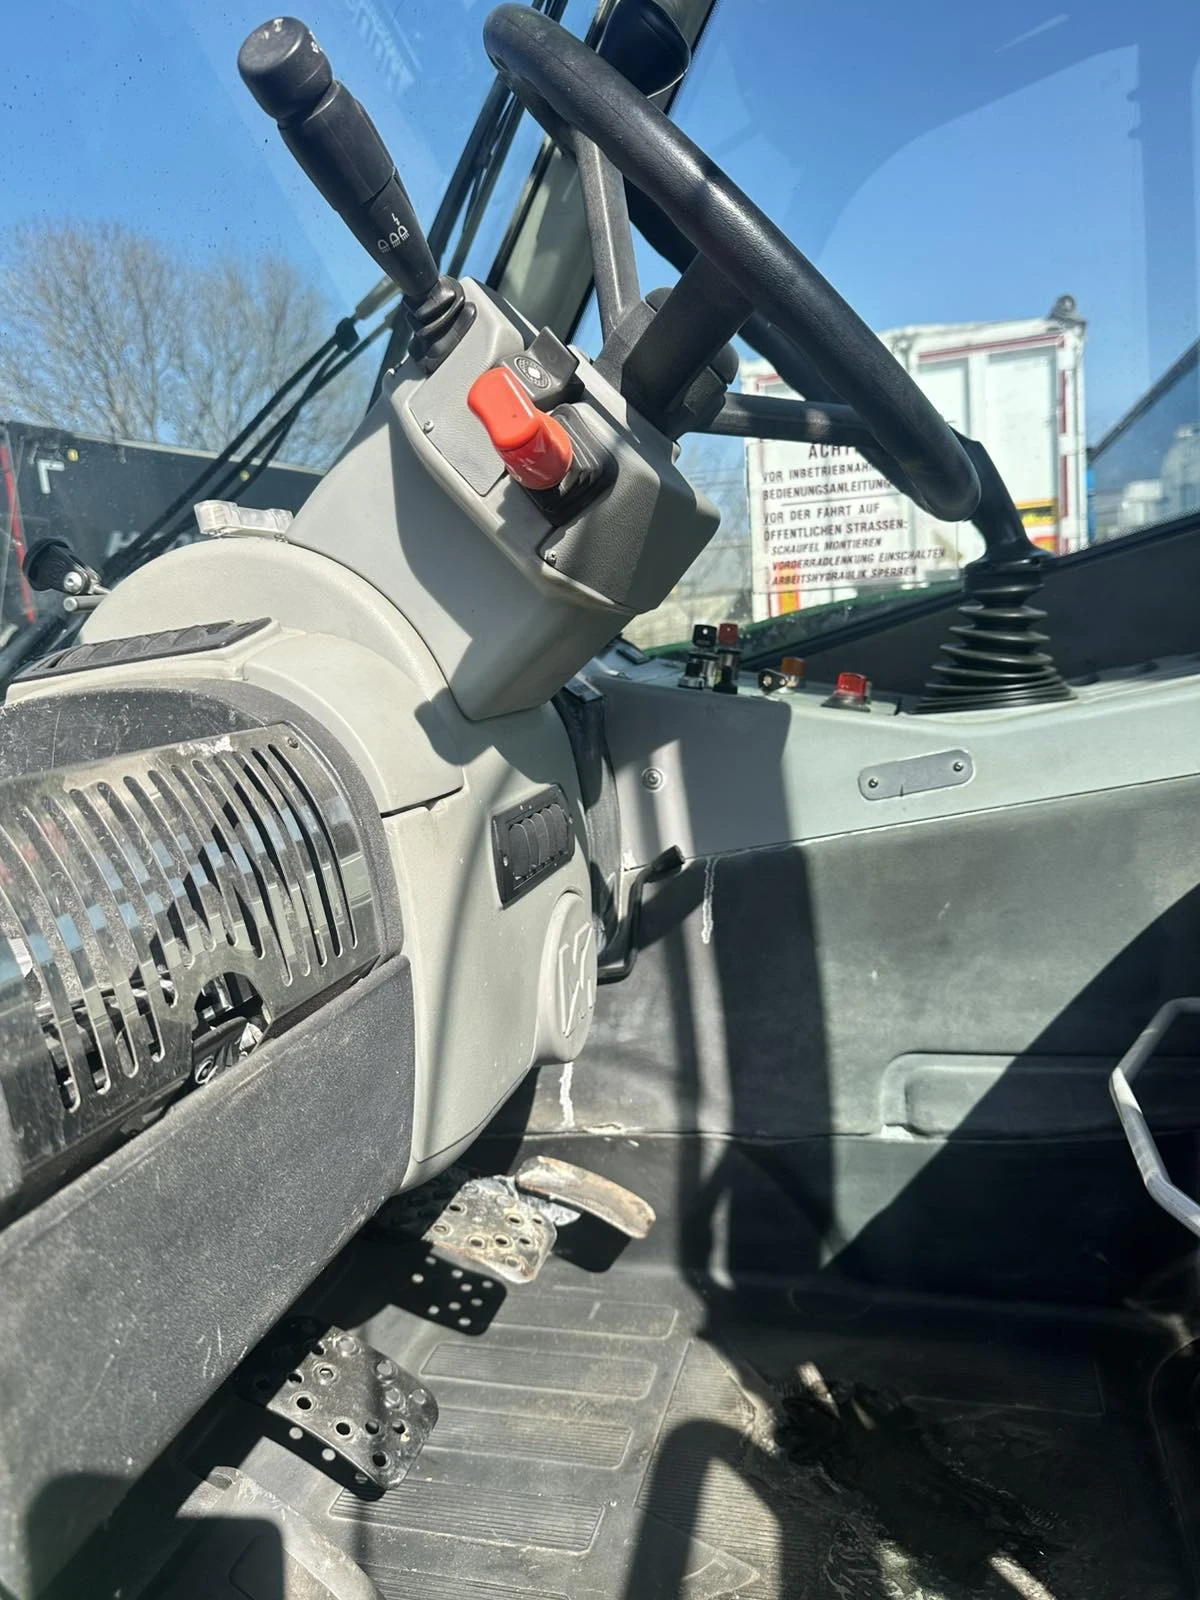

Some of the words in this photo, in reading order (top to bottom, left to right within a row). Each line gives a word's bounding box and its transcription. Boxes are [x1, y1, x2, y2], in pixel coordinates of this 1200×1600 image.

[808, 444, 856, 460] ACHT
[763, 471, 783, 483] VOR
[789, 463, 874, 480] INBETRIEBNAH
[762, 479, 891, 501] BEDIENUNGSANLEITUNG
[764, 511, 784, 524] VOR
[790, 509, 811, 521] DER
[817, 505, 852, 519] FAHRT
[858, 503, 880, 514] AUF
[772, 543, 820, 556] SCHAUFEL
[824, 537, 882, 551] MONTIEREN
[773, 553, 874, 571] VORDERRADLENKUNG
[879, 547, 945, 563] EINSCHALTEN
[772, 569, 866, 585] ARBEITSHYDRAULIK
[871, 566, 917, 579] SPERREN
